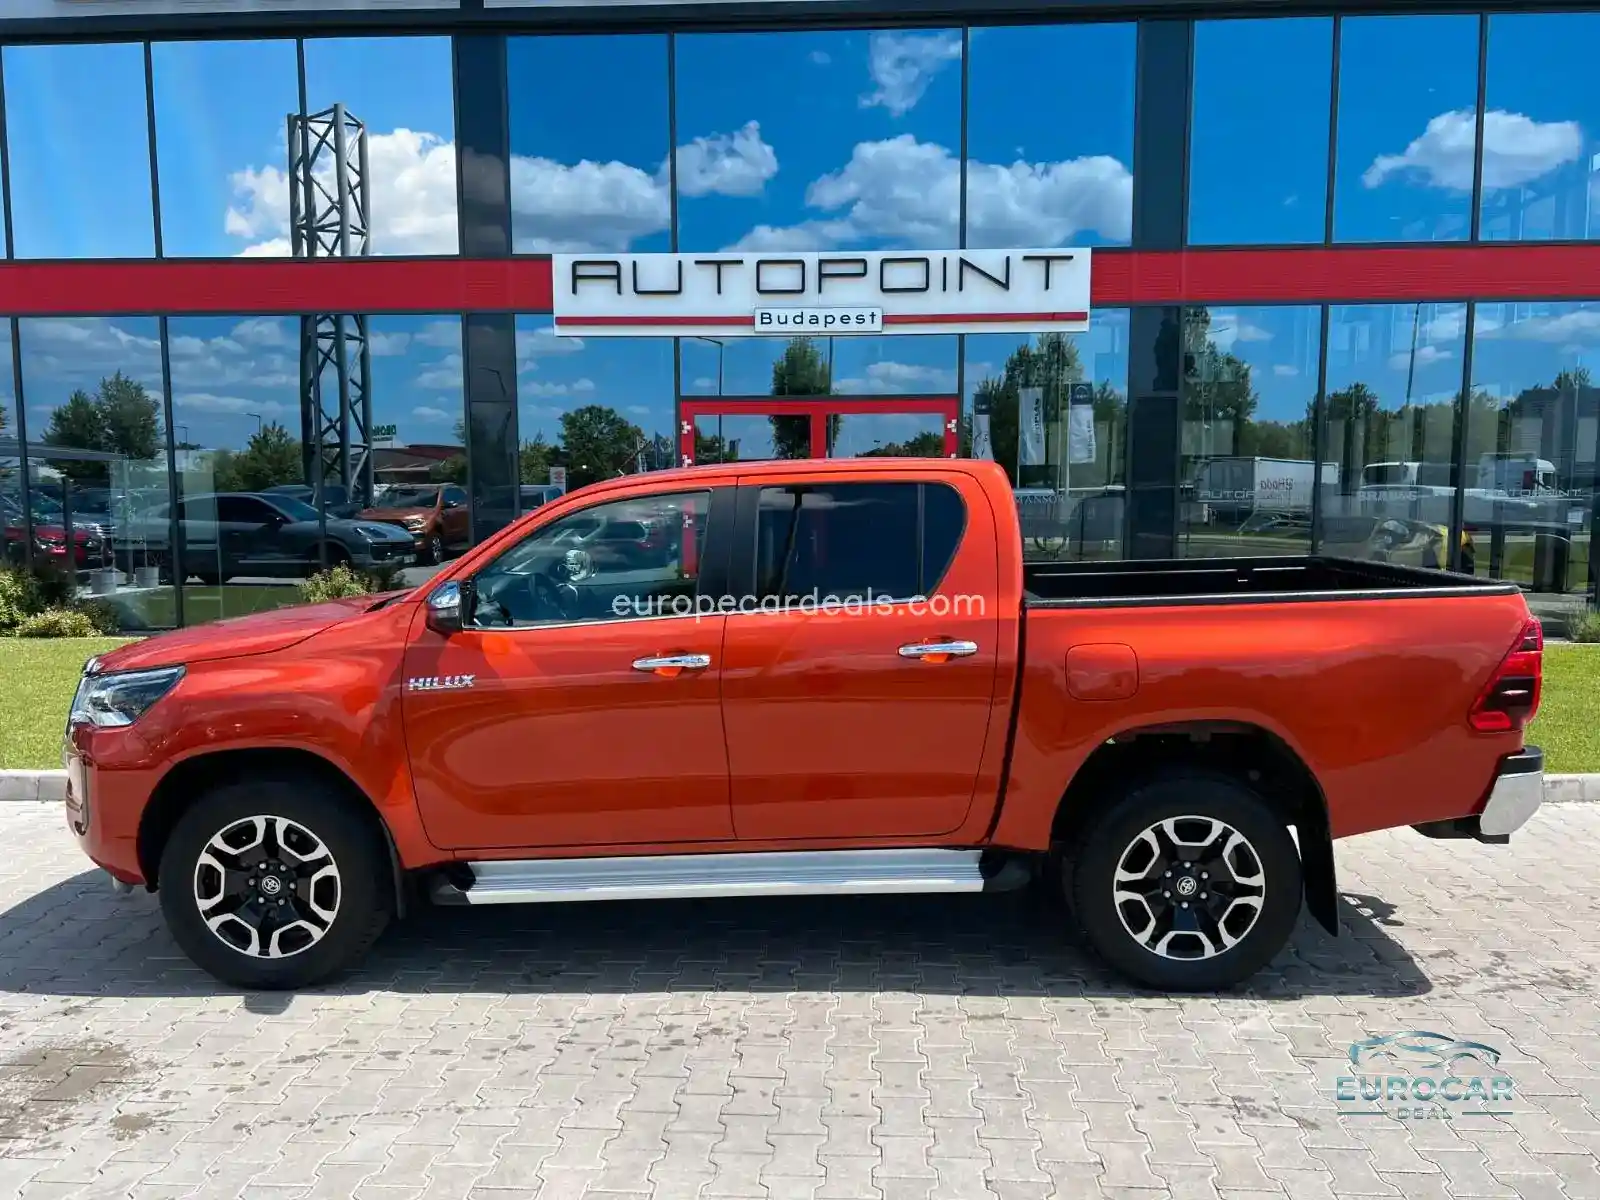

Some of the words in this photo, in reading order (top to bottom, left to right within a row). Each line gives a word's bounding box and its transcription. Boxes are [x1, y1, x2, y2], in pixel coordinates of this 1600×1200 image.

[571, 255, 1075, 295] AUTOPOINT
[760, 311, 878, 328] Budapest
[1014, 494, 1070, 505] MANSOR
[408, 674, 476, 691] HILUX
